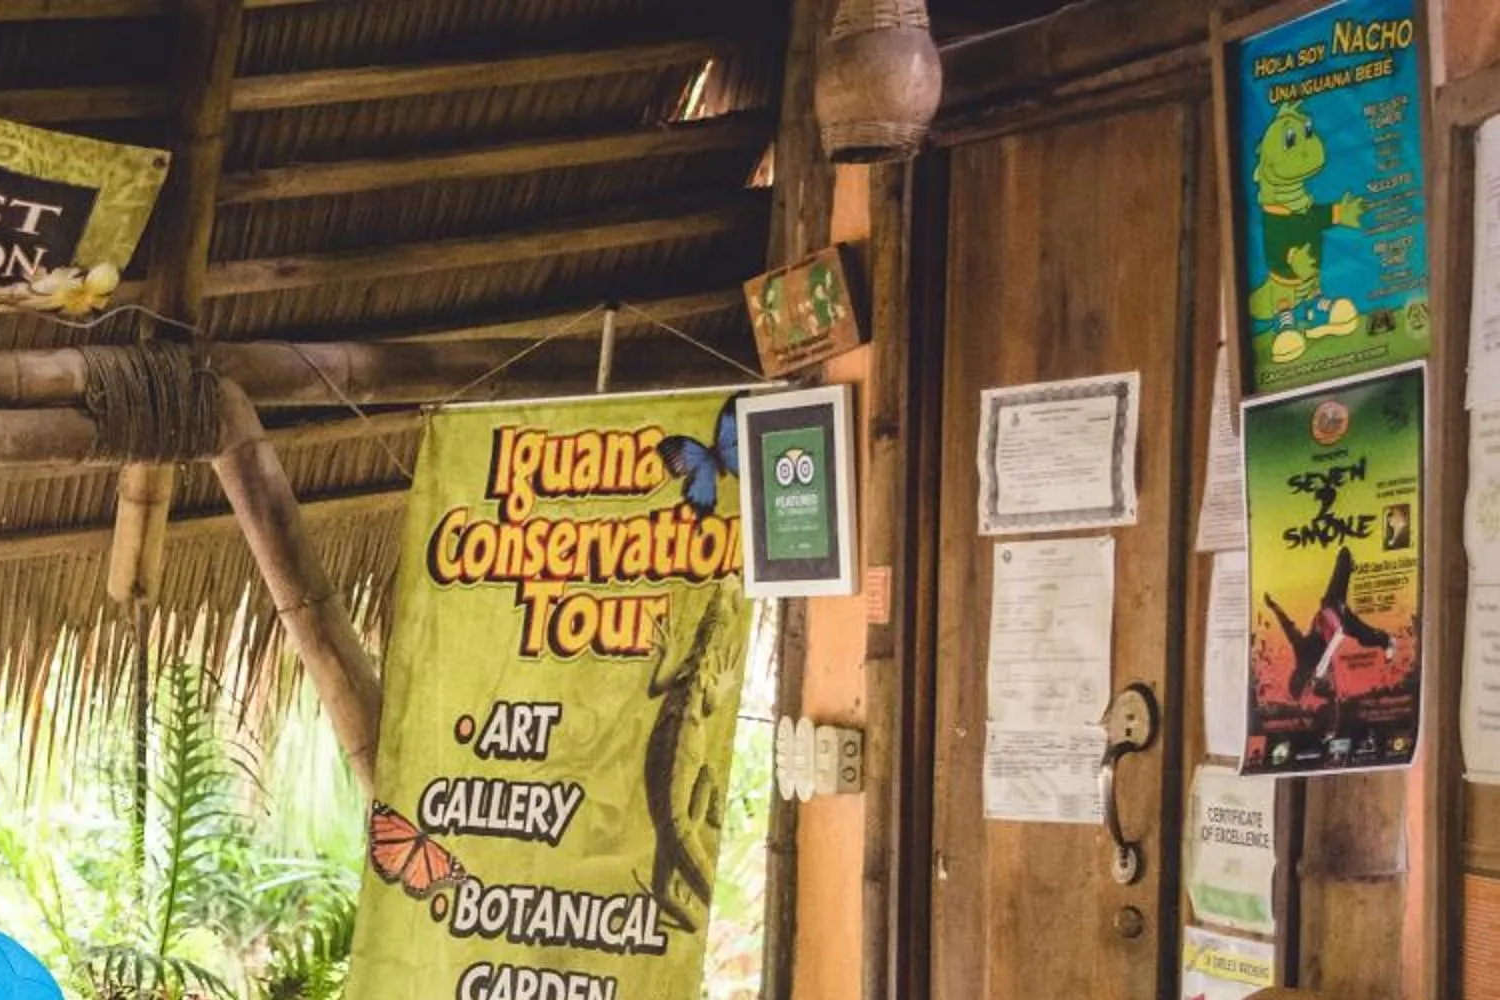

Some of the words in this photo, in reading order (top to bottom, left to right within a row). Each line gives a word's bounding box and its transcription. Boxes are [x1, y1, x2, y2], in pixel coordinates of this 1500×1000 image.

[1254, 54, 1294, 77] HOLA
[1297, 44, 1325, 67] SOY
[1332, 18, 1413, 55] NACHO
[1269, 83, 1298, 104] UNA
[1300, 69, 1352, 96] IGUANA
[490, 424, 666, 516] Iguana
[1287, 456, 1367, 494] SEVEN
[1282, 514, 1377, 549] SMOKE
[518, 580, 669, 656] Tour
[477, 703, 560, 759] ART
[420, 778, 583, 845] GALLERY
[1201, 825, 1213, 842] OF
[1215, 827, 1269, 849] EXCELLENCE
[1207, 807, 1263, 828] CERTIFICATE
[453, 879, 664, 949] BOTANICAL
